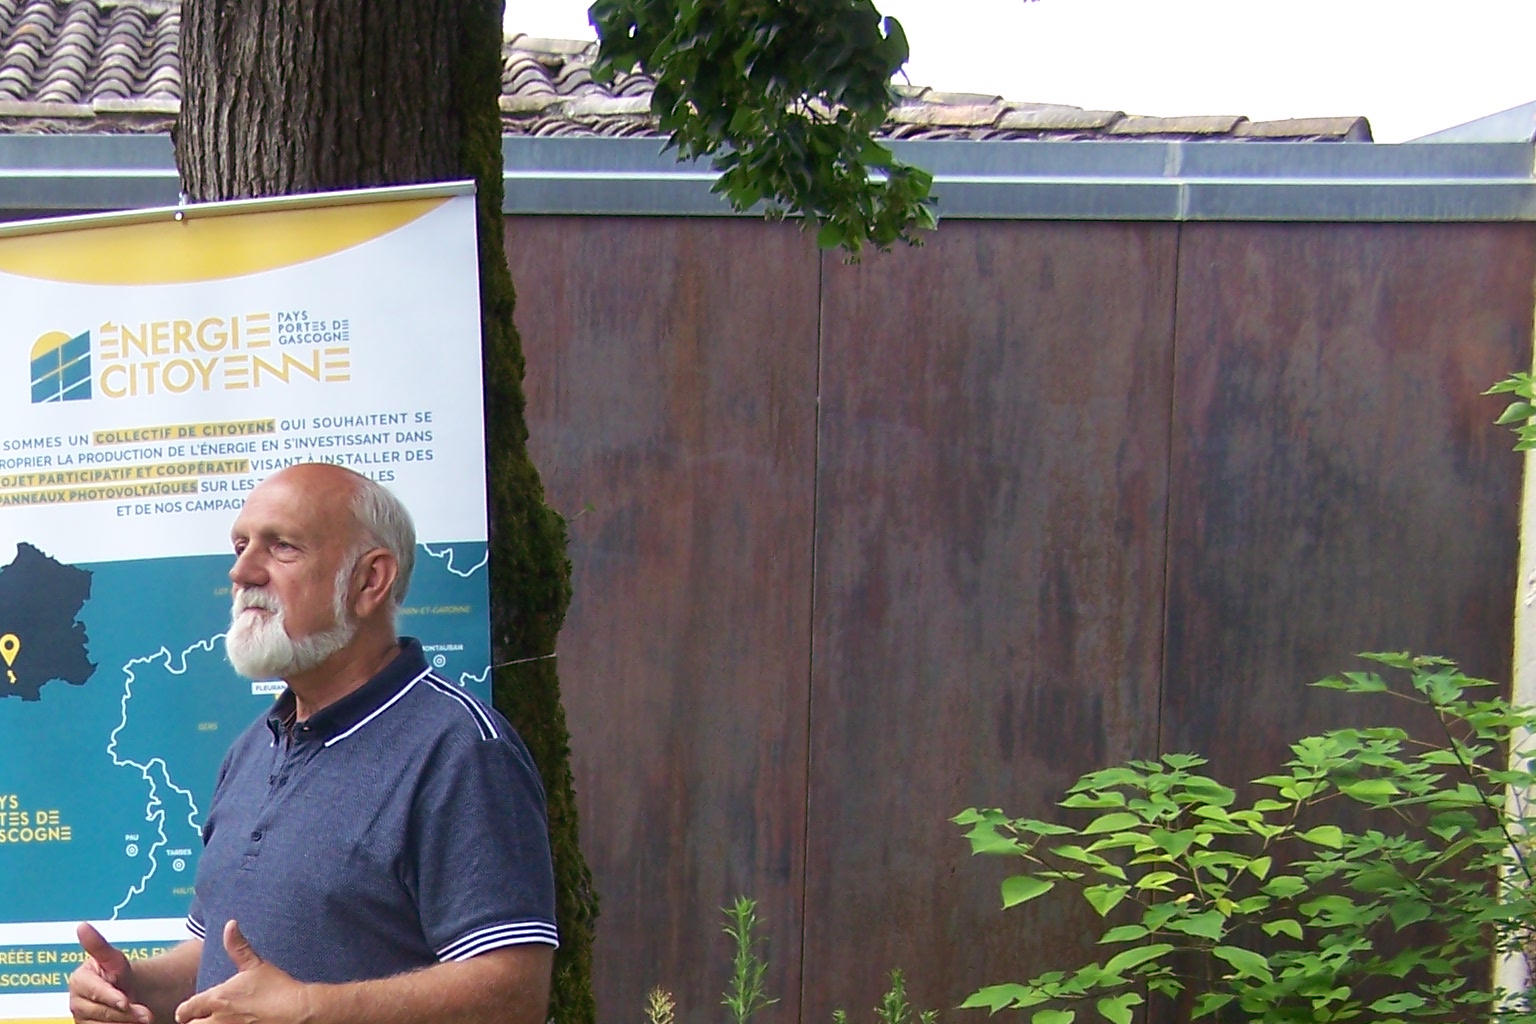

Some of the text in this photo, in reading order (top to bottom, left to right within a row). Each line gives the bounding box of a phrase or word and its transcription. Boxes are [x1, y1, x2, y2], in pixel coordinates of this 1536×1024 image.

[278, 311, 308, 323] PAYS
[278, 319, 350, 334] PORTES DE
[100, 313, 271, 361] ÉNERGIE
[278, 331, 350, 345] GASCOGNE
[100, 347, 351, 399] CITOYENNE
[3, 436, 63, 452] SOMMES
[68, 434, 90, 447] UN
[95, 427, 173, 445] COLLECTIF
[178, 424, 196, 437] DE
[202, 420, 275, 438] CITOYENS
[280, 418, 306, 431] QUI
[313, 412, 408, 429] SOUHAITENT
[414, 411, 433, 423] SE
[57, 453, 74, 466] LA
[78, 448, 163, 465] PRODUCTION
[168, 446, 185, 458] DE
[262, 439, 279, 452] EN
[395, 430, 433, 444] DANS
[38, 469, 133, 486] PARTICIPATIF
[136, 466, 152, 479] ET
[156, 459, 249, 477] COOPÉRATIF
[320, 450, 400, 466] INSTALLER
[405, 449, 434, 462] DES
[69, 480, 198, 501] PHOTOVOLTAÏQUES
[201, 480, 227, 493] SUR
[232, 478, 255, 491] LES
[116, 504, 132, 517] ET
[135, 503, 152, 515] DE
[155, 501, 183, 514] NOS
[36, 810, 60, 825] DE
[37, 950, 57, 963] EN
